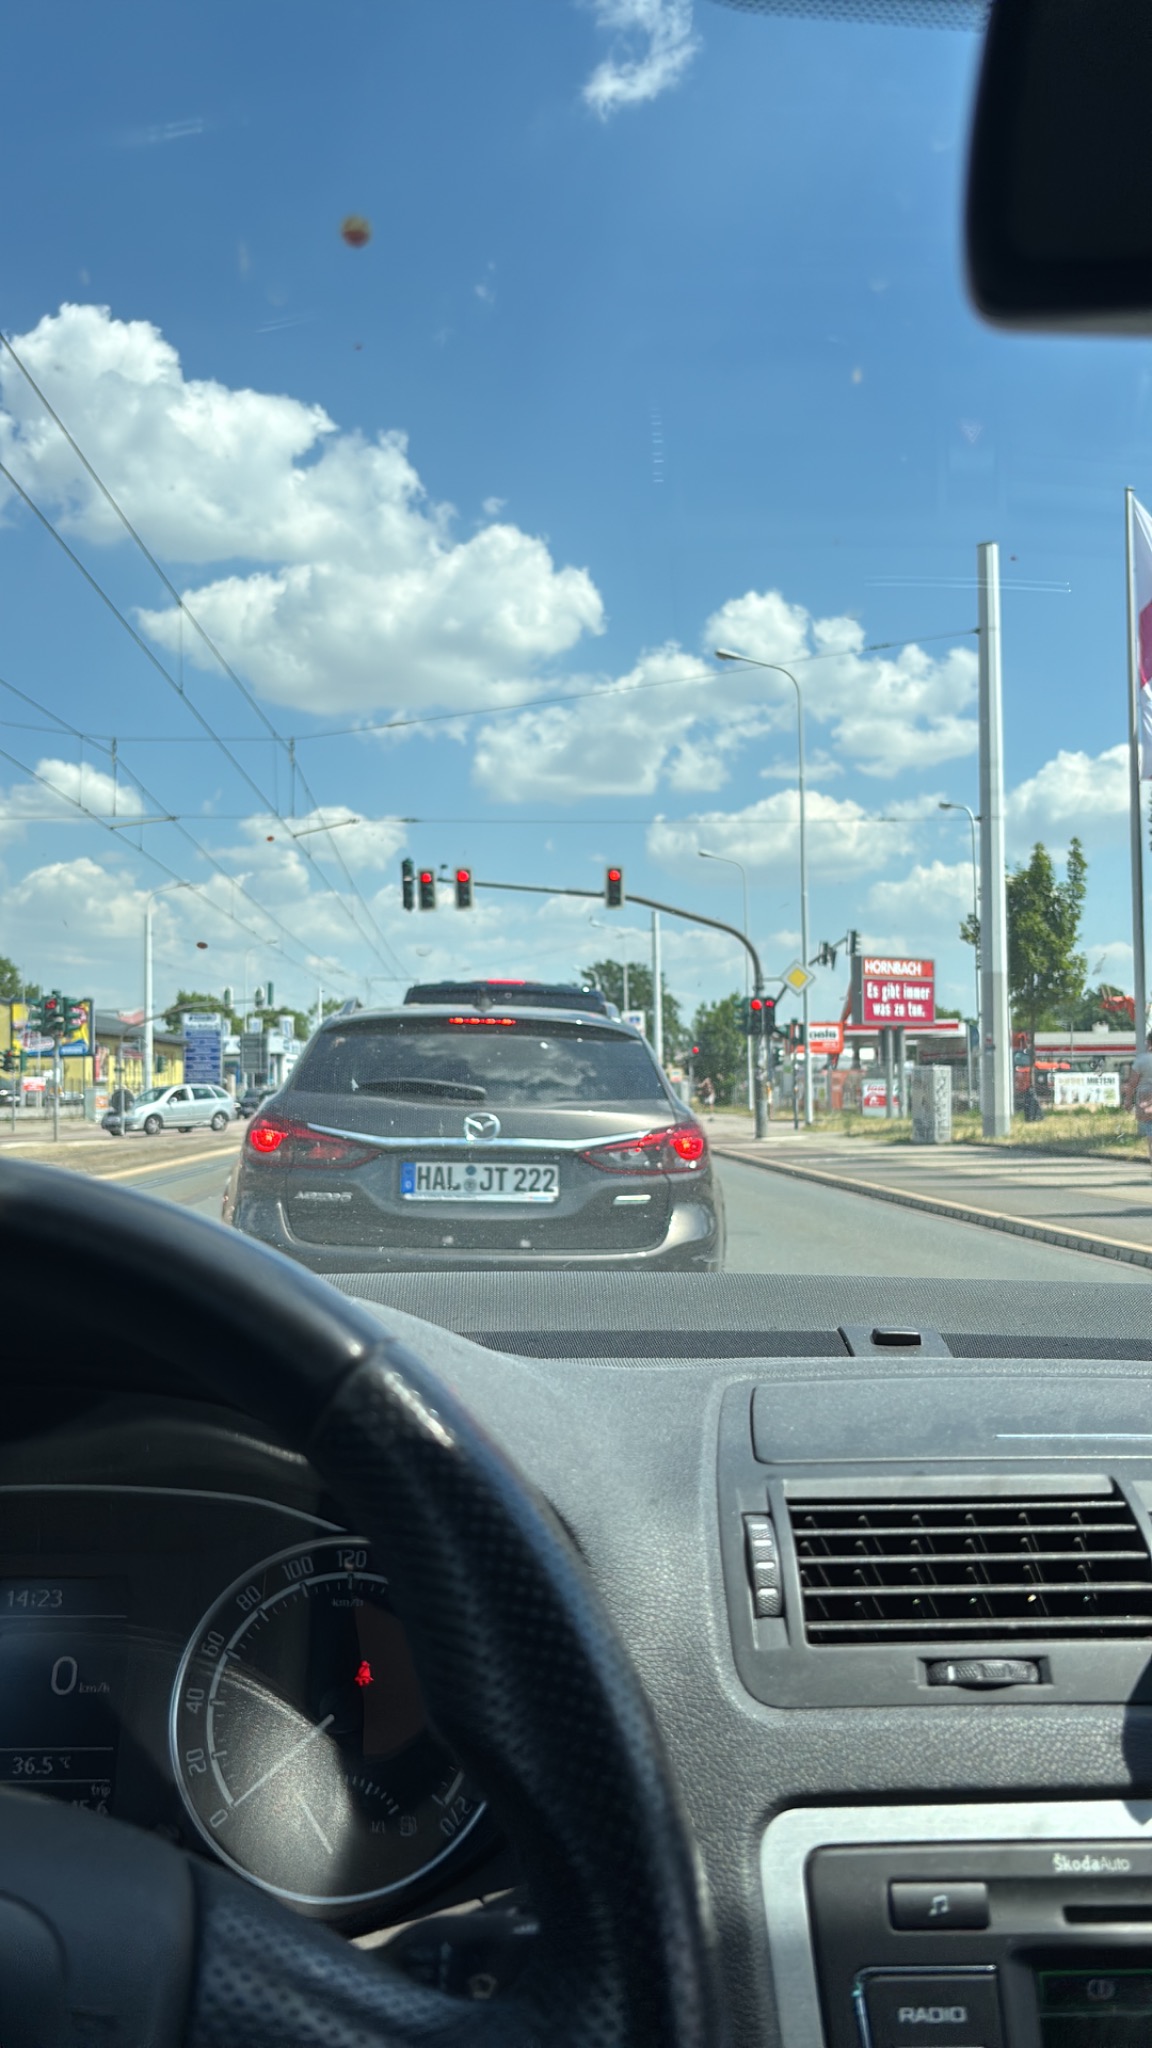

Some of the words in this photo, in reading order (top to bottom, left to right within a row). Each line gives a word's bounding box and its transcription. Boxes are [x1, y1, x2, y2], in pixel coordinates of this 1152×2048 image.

[864, 959, 921, 975] HORNBACH
[866, 982, 879, 999] Es
[881, 983, 901, 1003] gibt
[903, 984, 931, 1001] immer
[872, 1003, 891, 1017] was
[893, 1004, 906, 1016] zu
[907, 1003, 926, 1018] tun.
[416, 1165, 461, 1191] HAL
[480, 1167, 509, 1192] JT
[514, 1167, 556, 1193] 222
[281, 1555, 315, 1583] 100
[337, 1550, 368, 1568] 120
[6, 1588, 64, 1609] 14:23
[236, 1585, 263, 1613] 80
[332, 1597, 364, 1609] km/h
[201, 1631, 226, 1658] 60
[50, 1655, 79, 1696] 0
[79, 1681, 111, 1694] km/h
[185, 1688, 206, 1714] 40
[12, 1756, 54, 1775] 36.5
[186, 1749, 208, 1776] 20
[91, 1782, 111, 1798] trip
[210, 1808, 229, 1828] 0
[439, 1795, 473, 1837] 270
[899, 2007, 967, 2023] RADIO
